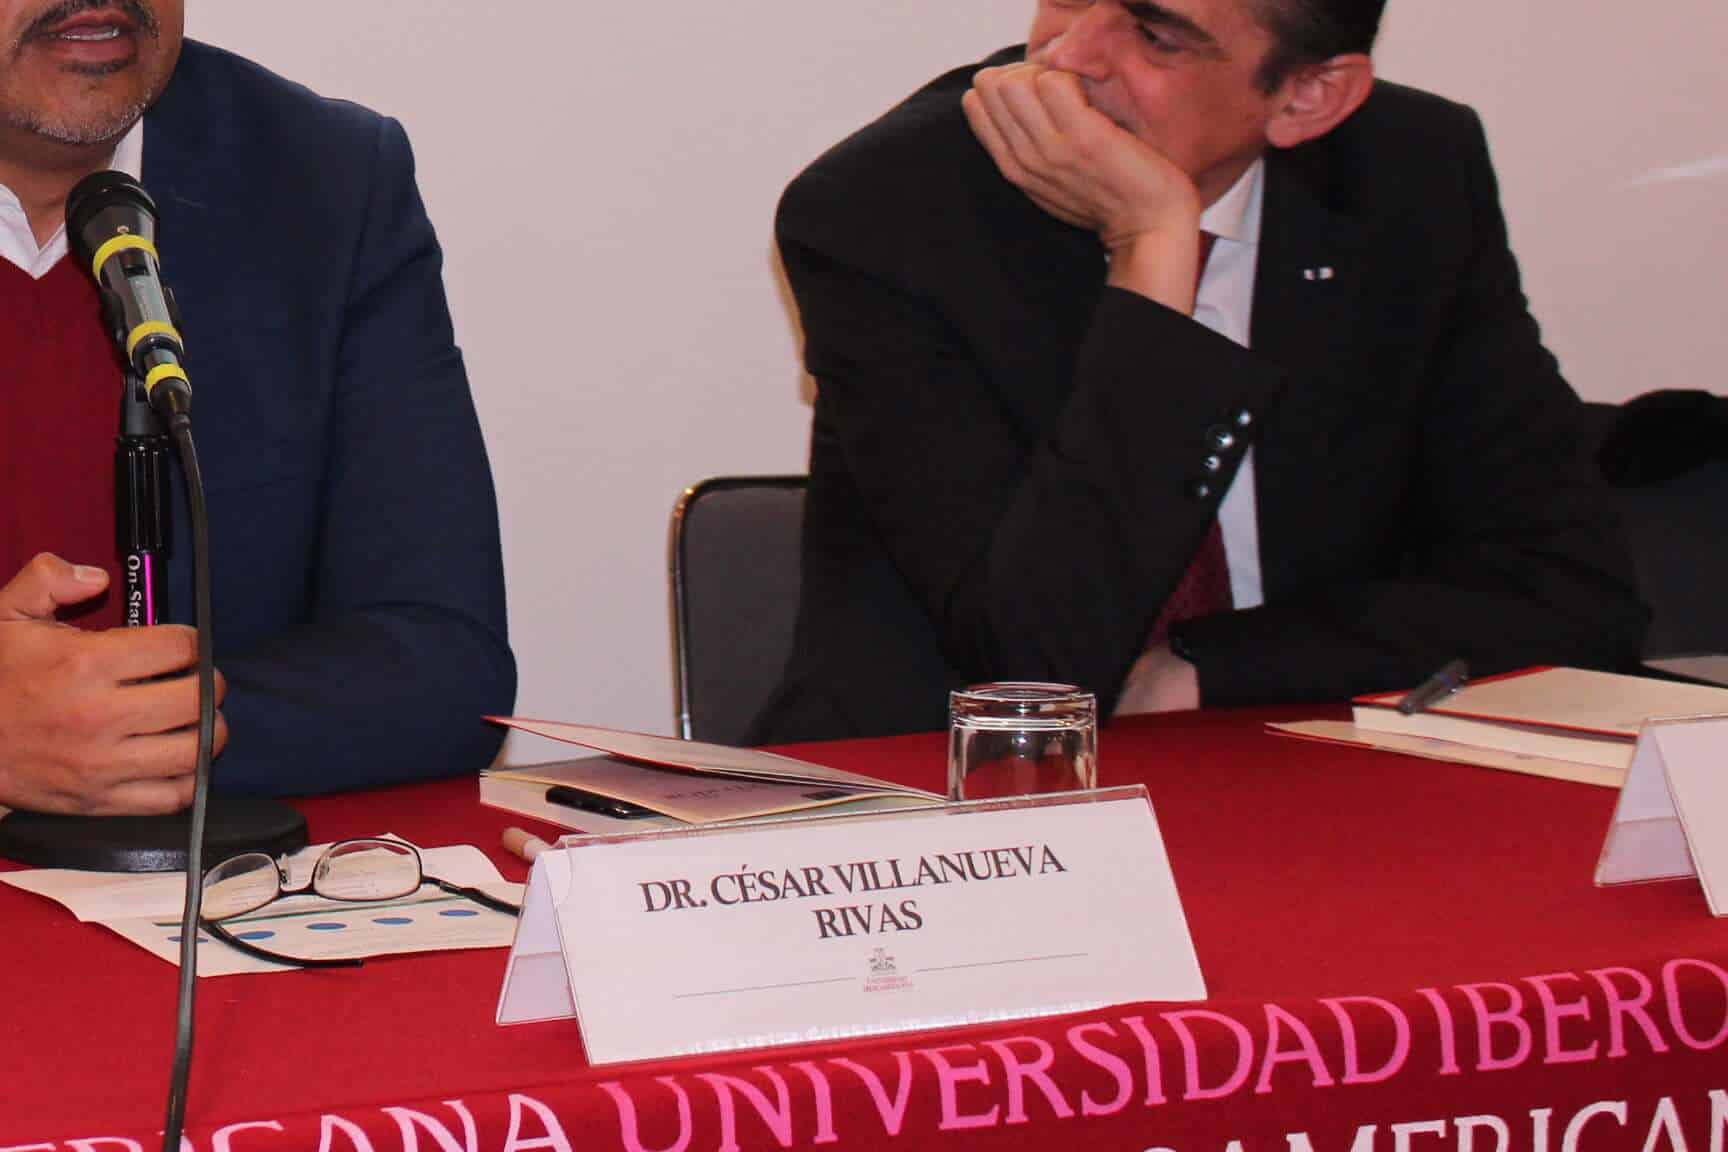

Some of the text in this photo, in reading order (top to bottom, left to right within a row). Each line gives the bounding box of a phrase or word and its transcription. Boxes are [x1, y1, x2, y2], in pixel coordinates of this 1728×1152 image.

[638, 844, 1068, 913] DR. CÉSAR VILLANUEVA
[814, 899, 924, 940] RIVAS
[596, 996, 1411, 1152] UNIVERSIDAD
